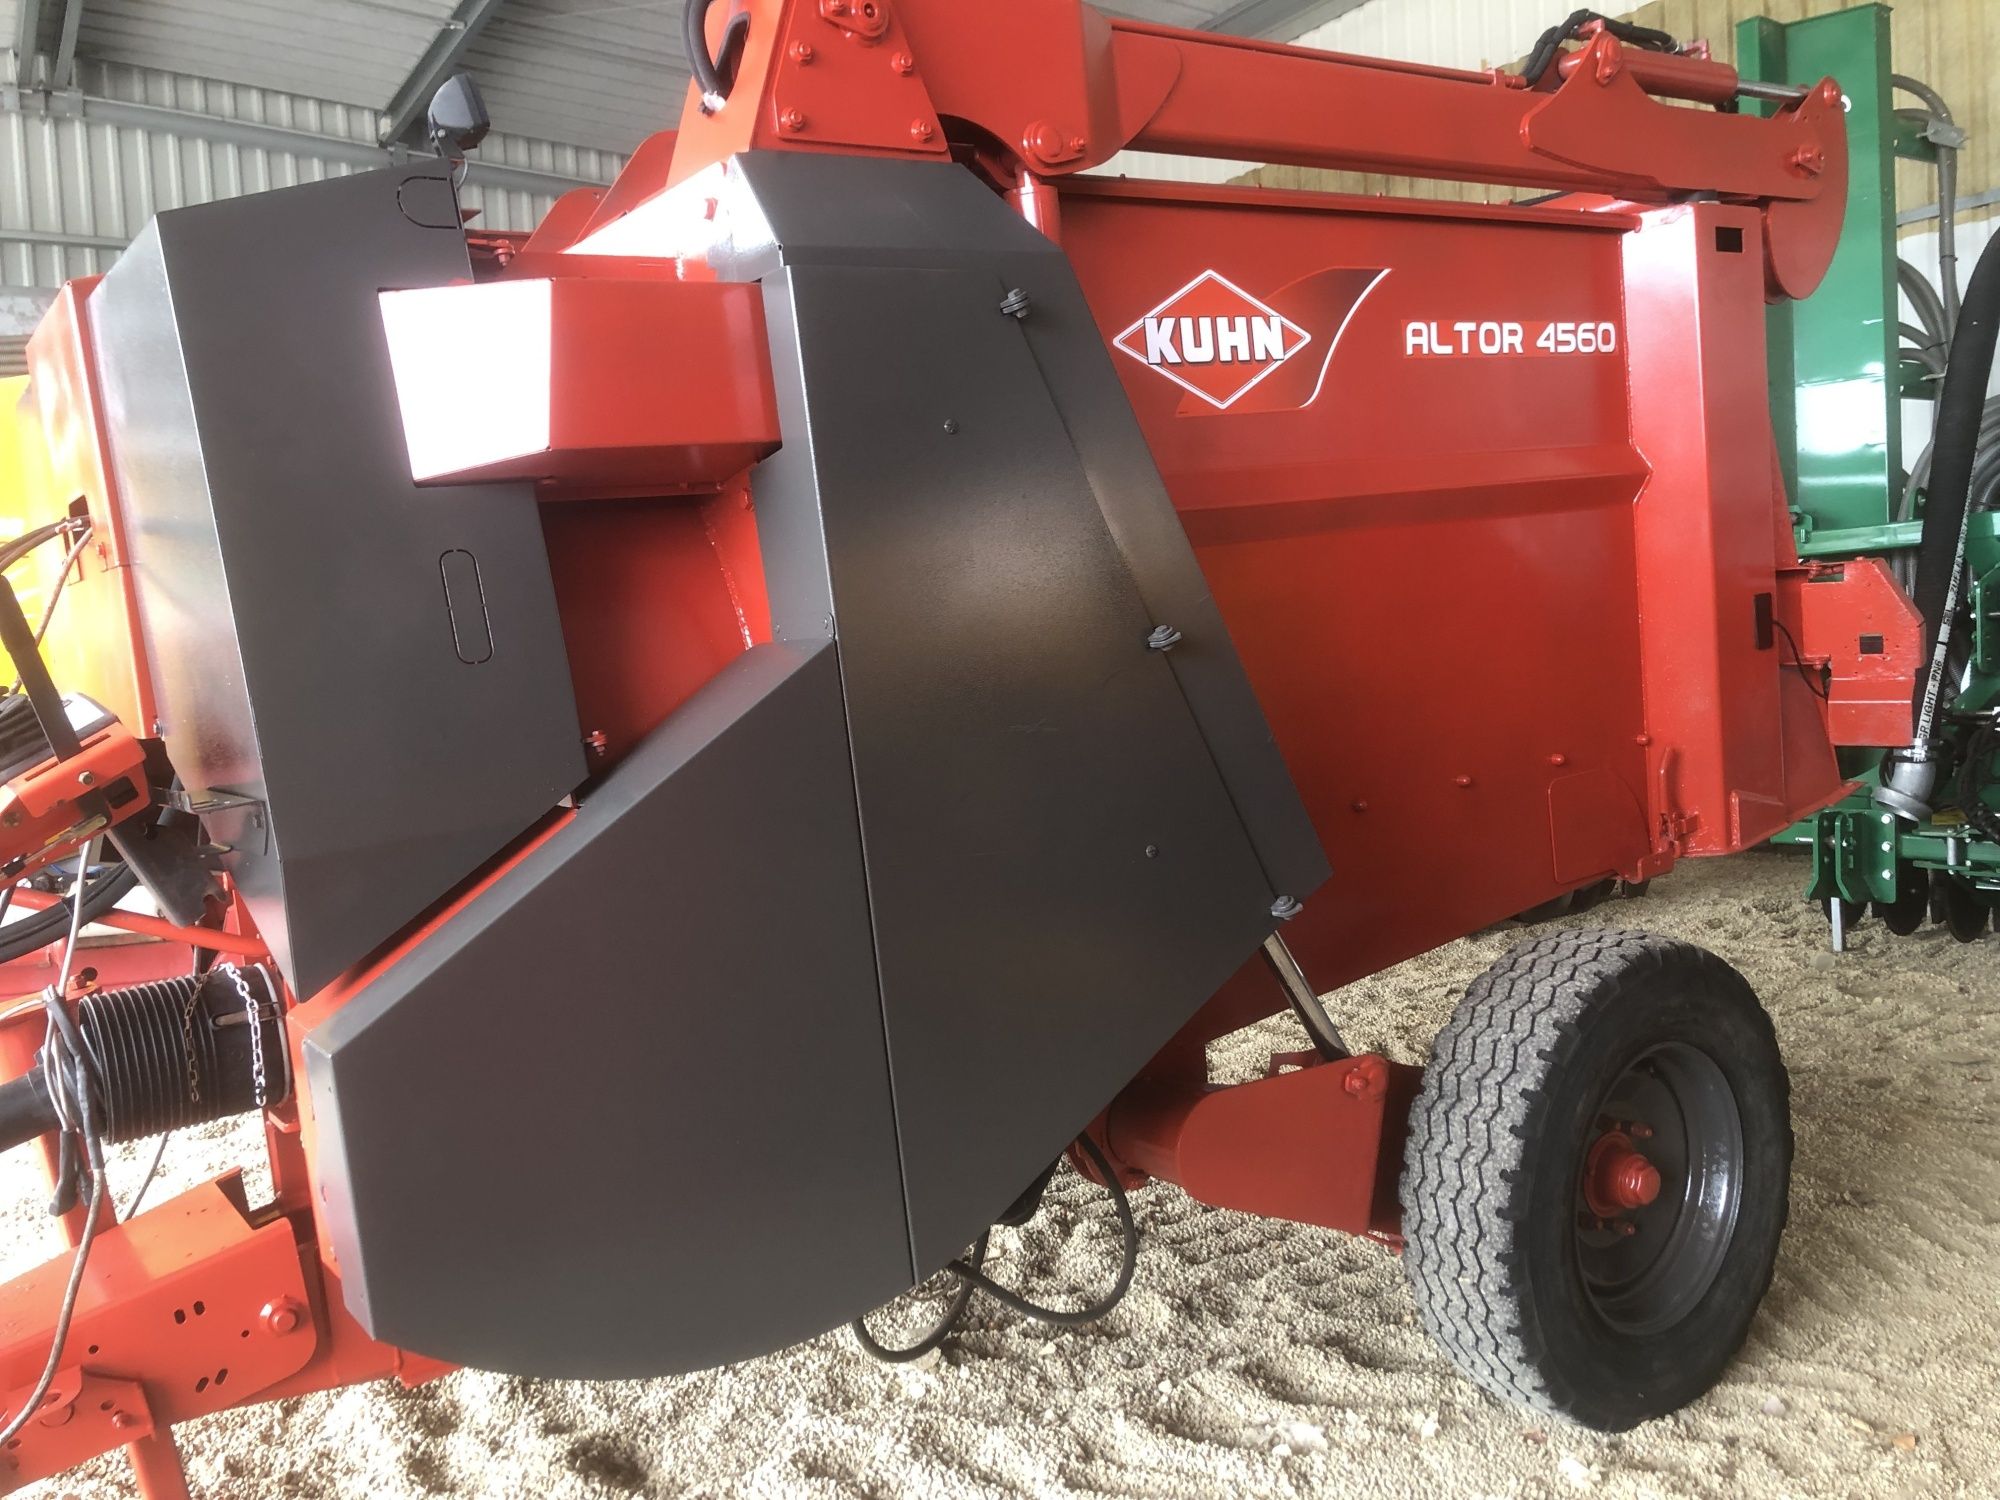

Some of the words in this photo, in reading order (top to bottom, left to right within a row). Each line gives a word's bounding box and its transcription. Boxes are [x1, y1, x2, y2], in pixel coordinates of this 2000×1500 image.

[1144, 316, 1285, 364] KUHN
[1406, 321, 1524, 355] ALTOR
[1536, 322, 1616, 354] 4560
[1922, 690, 1937, 723] LIGHT
